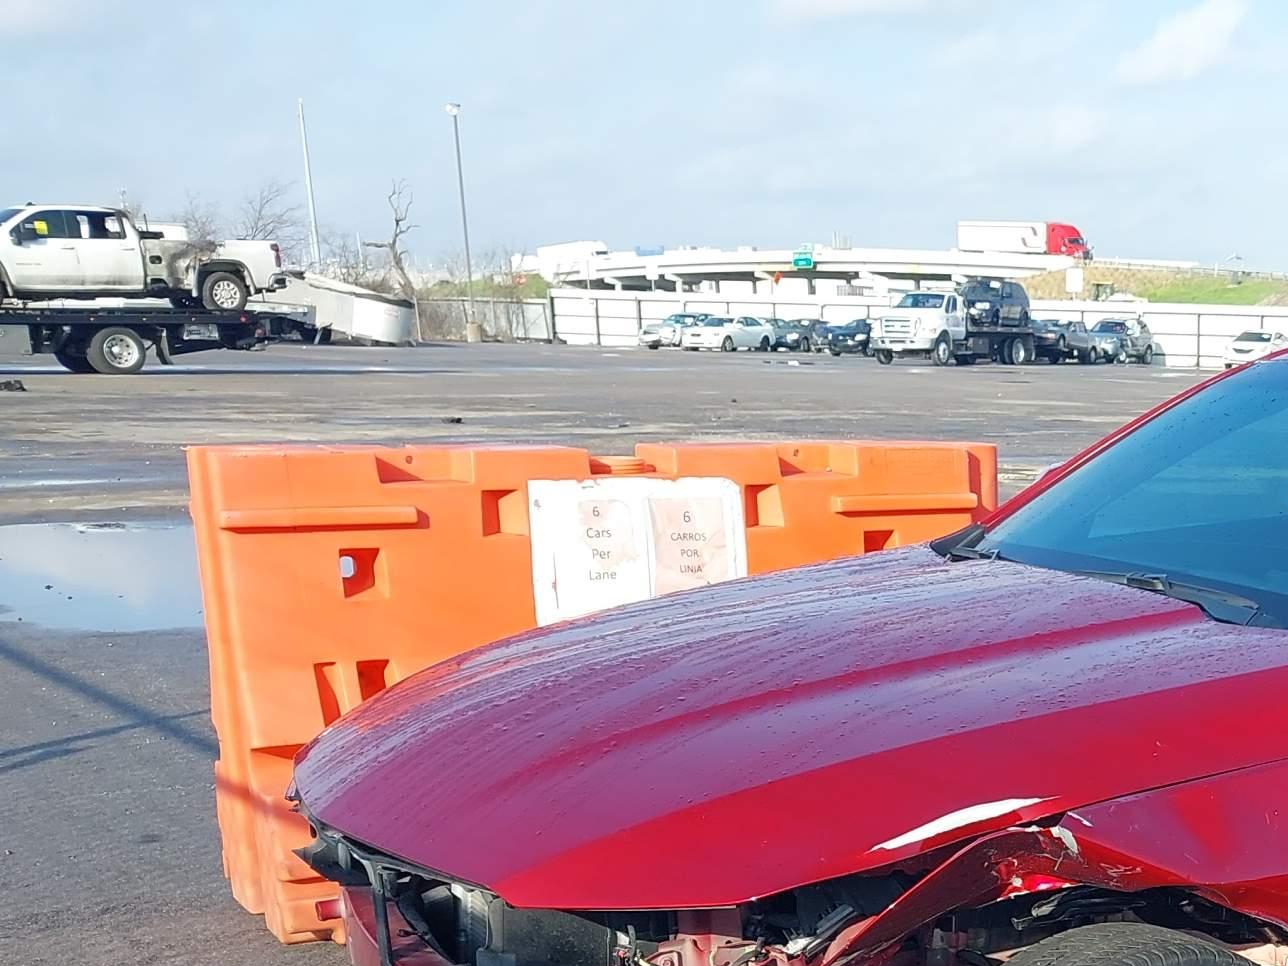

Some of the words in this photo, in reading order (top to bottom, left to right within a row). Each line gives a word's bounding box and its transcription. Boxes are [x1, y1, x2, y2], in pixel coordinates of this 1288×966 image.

[592, 505, 600, 517] 6
[683, 511, 691, 523] 6
[586, 527, 612, 538] Cars
[670, 532, 707, 542] CARROS
[592, 548, 611, 560] Per
[680, 548, 700, 558] POR
[589, 568, 617, 581] Lane
